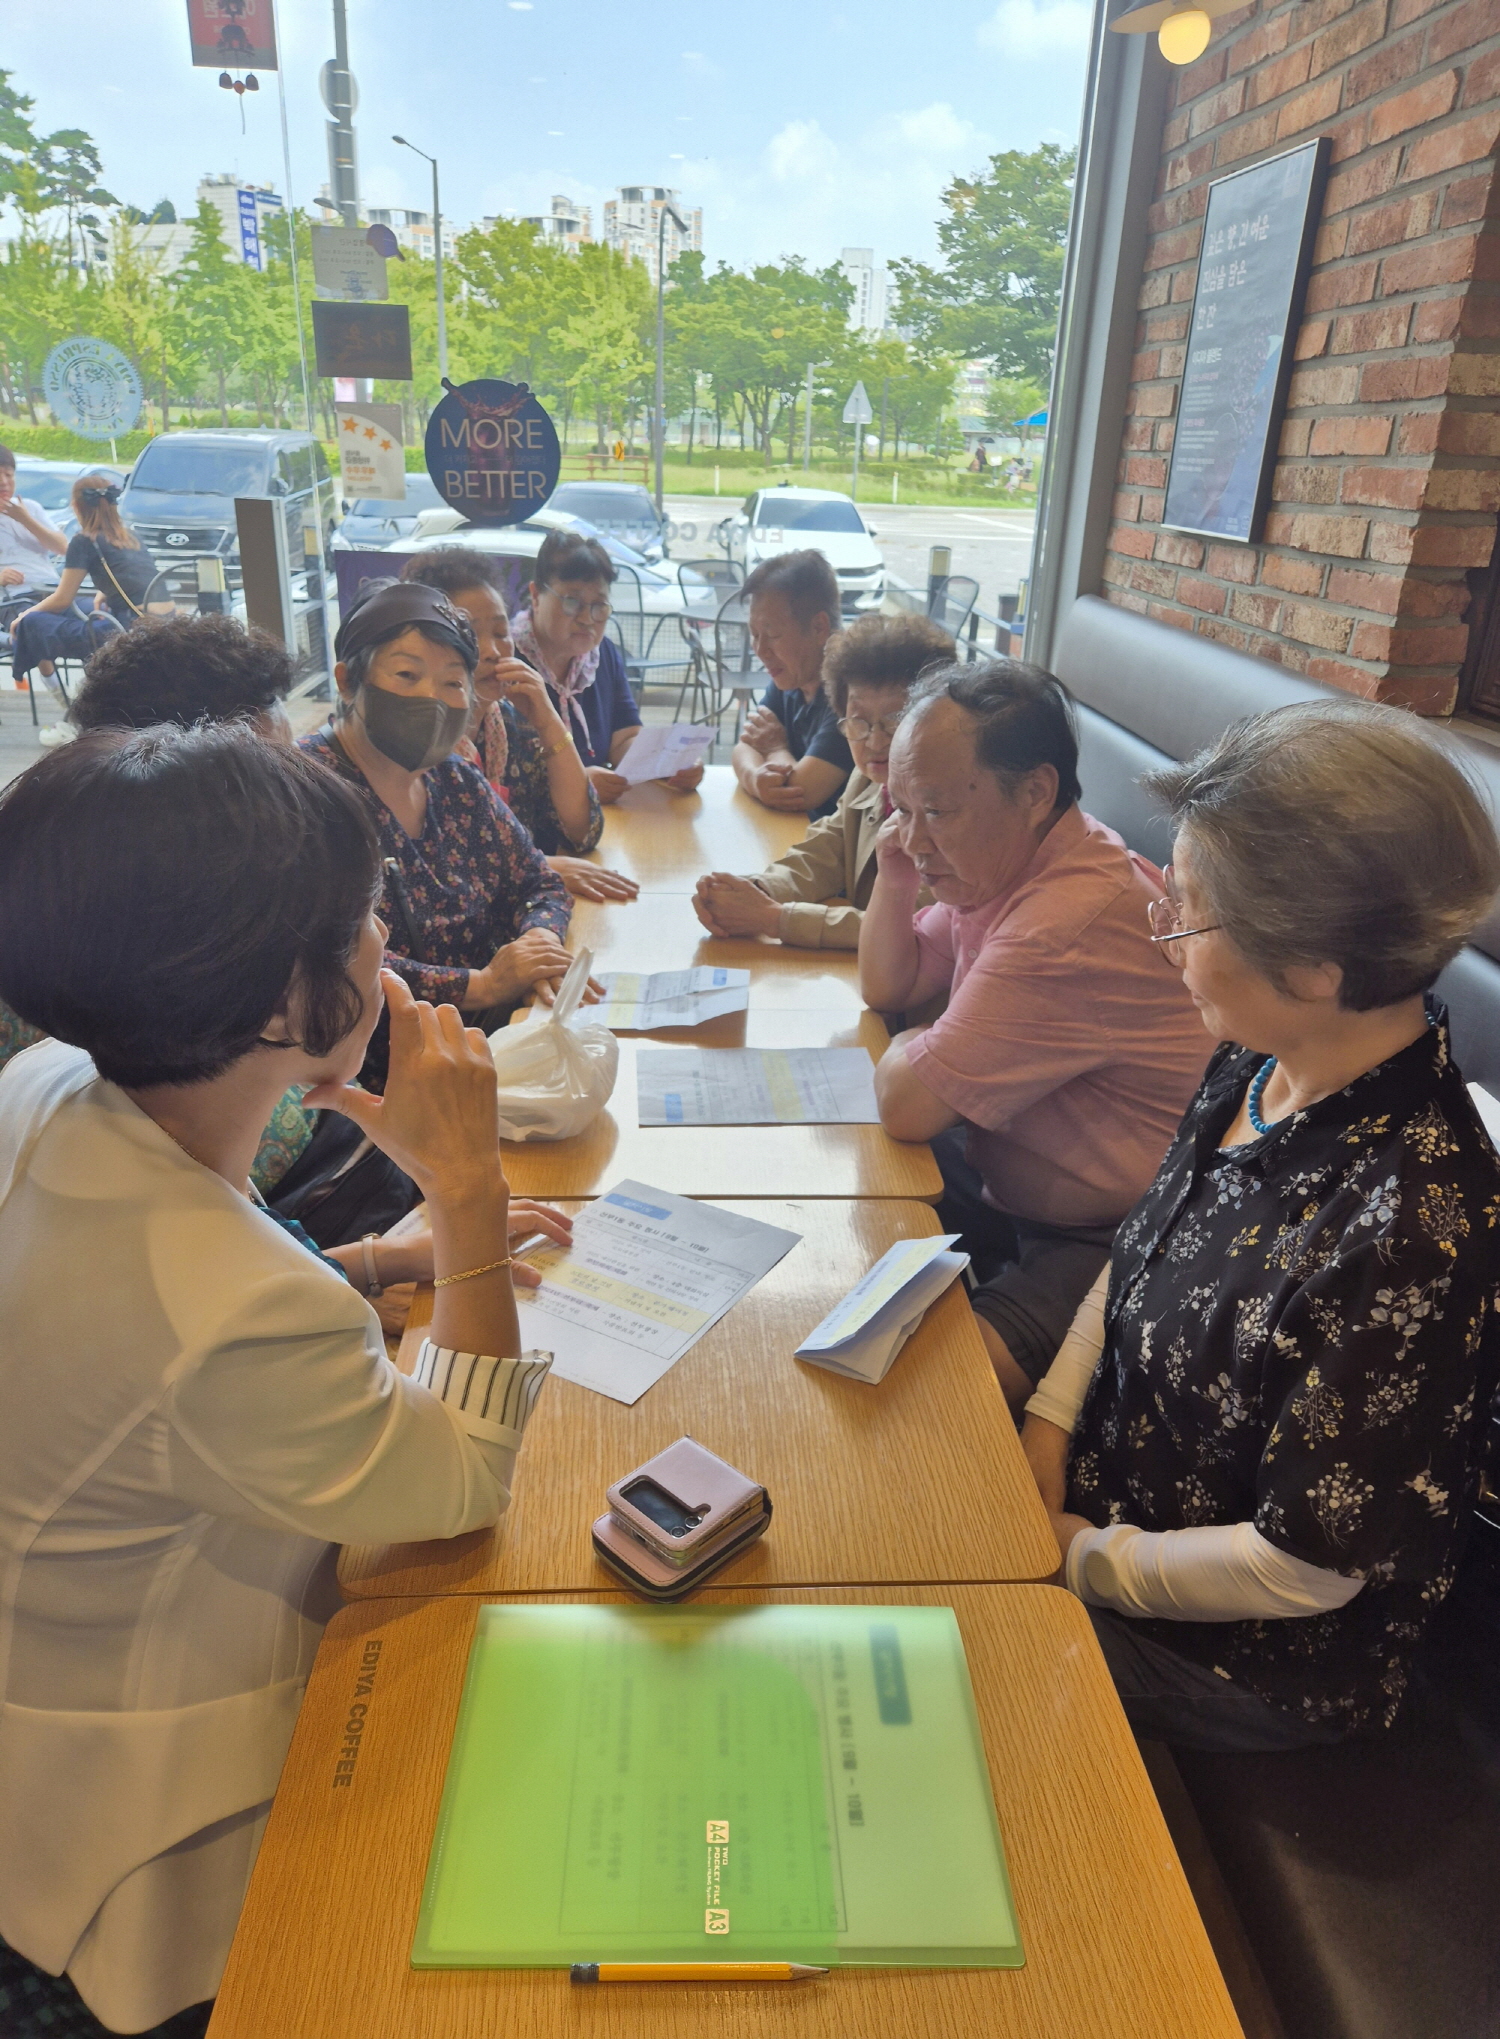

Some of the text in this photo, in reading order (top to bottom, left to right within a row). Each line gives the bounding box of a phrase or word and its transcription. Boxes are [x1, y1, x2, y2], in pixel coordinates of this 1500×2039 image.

[1238, 219, 1249, 247] 긴
[1250, 214, 1270, 242] 여운
[1202, 260, 1247, 293] 진심을 담은
[1196, 302, 1217, 330] 한 잔
[440, 418, 544, 449] MORE
[444, 470, 547, 499] BETTER
[332, 1640, 383, 1789] EDIYA COFFEE
[708, 1822, 727, 1842] A4
[708, 1911, 727, 1932] A3
